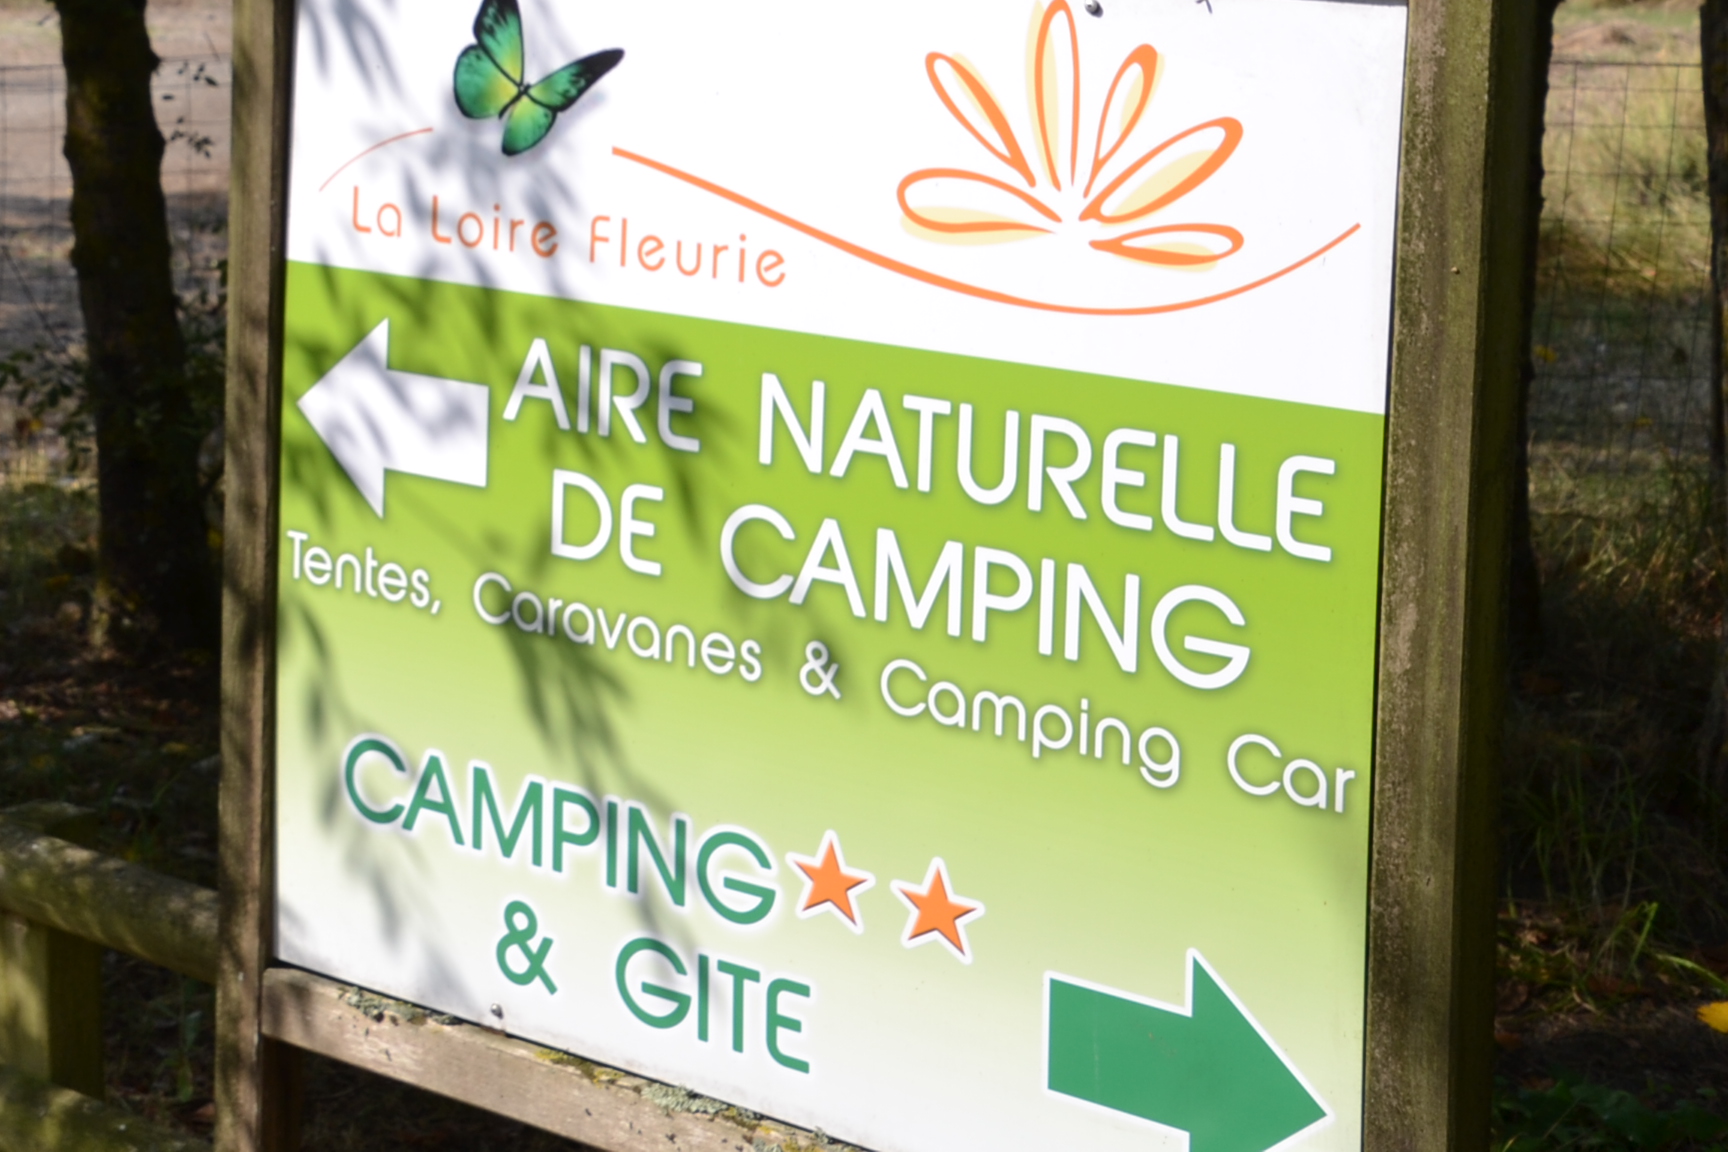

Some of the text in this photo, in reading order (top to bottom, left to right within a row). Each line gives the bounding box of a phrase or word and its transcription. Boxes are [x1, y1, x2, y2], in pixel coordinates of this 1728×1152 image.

[350, 185, 788, 289] La Loire Fleurie
[503, 336, 1337, 563] AIRE NATURELLE
[286, 530, 1357, 815] Tentes, Caravanes & Camping Car
[551, 466, 1252, 690] DE CAMPING
[344, 736, 778, 925] CAMPING
[496, 899, 813, 1074] & GITE
